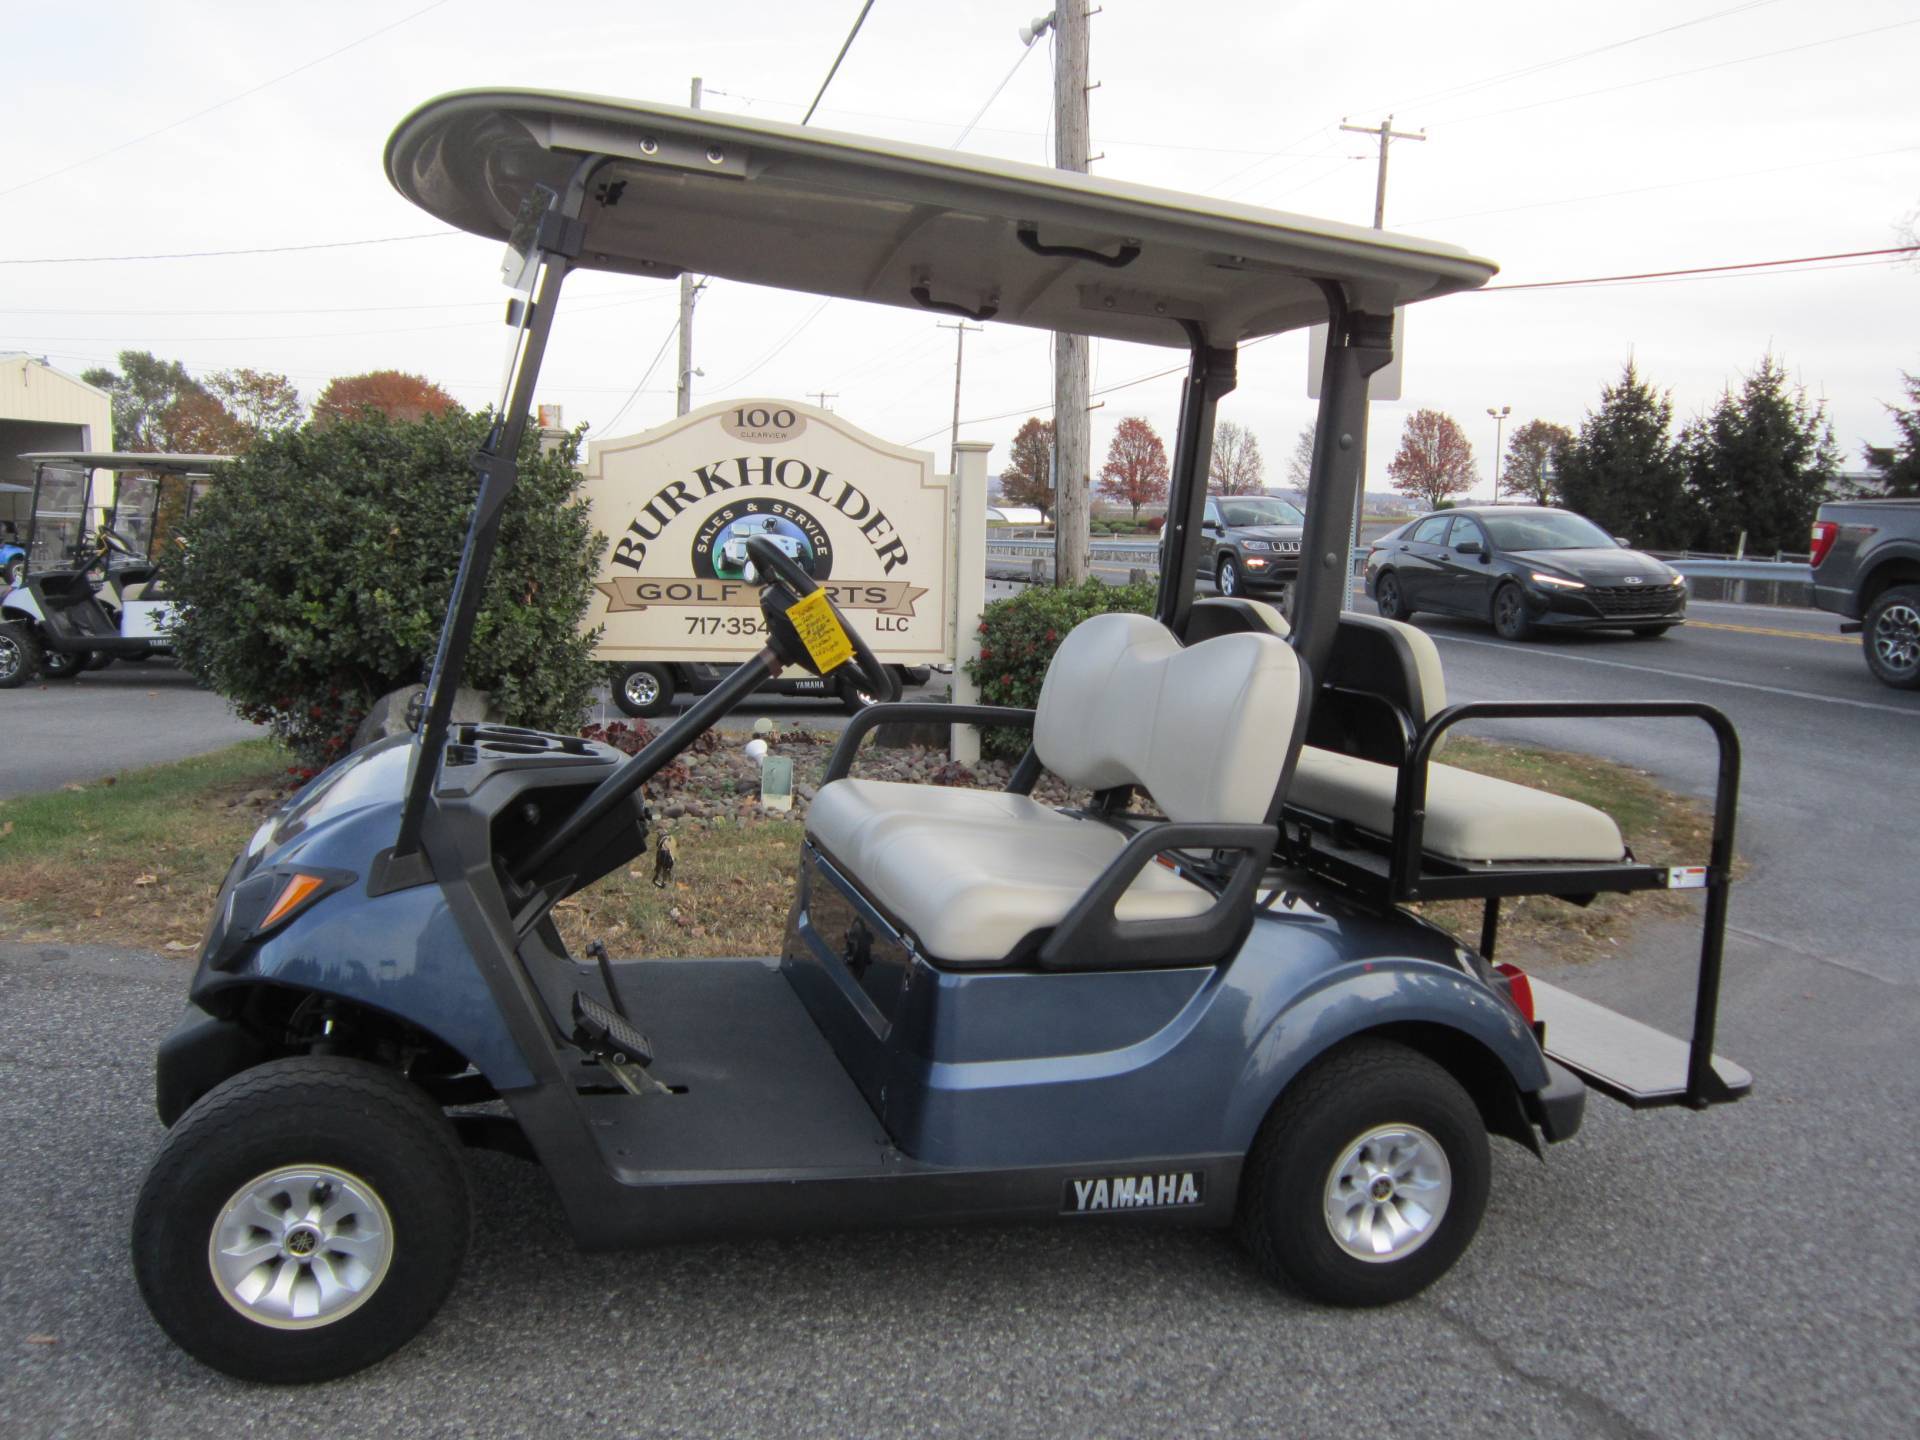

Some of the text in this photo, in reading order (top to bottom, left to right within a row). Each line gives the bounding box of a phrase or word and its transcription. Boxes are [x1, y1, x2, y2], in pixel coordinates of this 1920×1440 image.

[734, 408, 796, 429] 100
[740, 431, 788, 439] CLEARVIEW
[611, 456, 908, 575] BURKHOLDER
[697, 503, 828, 556] SALES & SERVICE
[636, 583, 742, 601] GOLF
[876, 617, 909, 632] LLC
[795, 681, 825, 689] YAMAHA
[1073, 1172, 1196, 1211] YAMAHA
